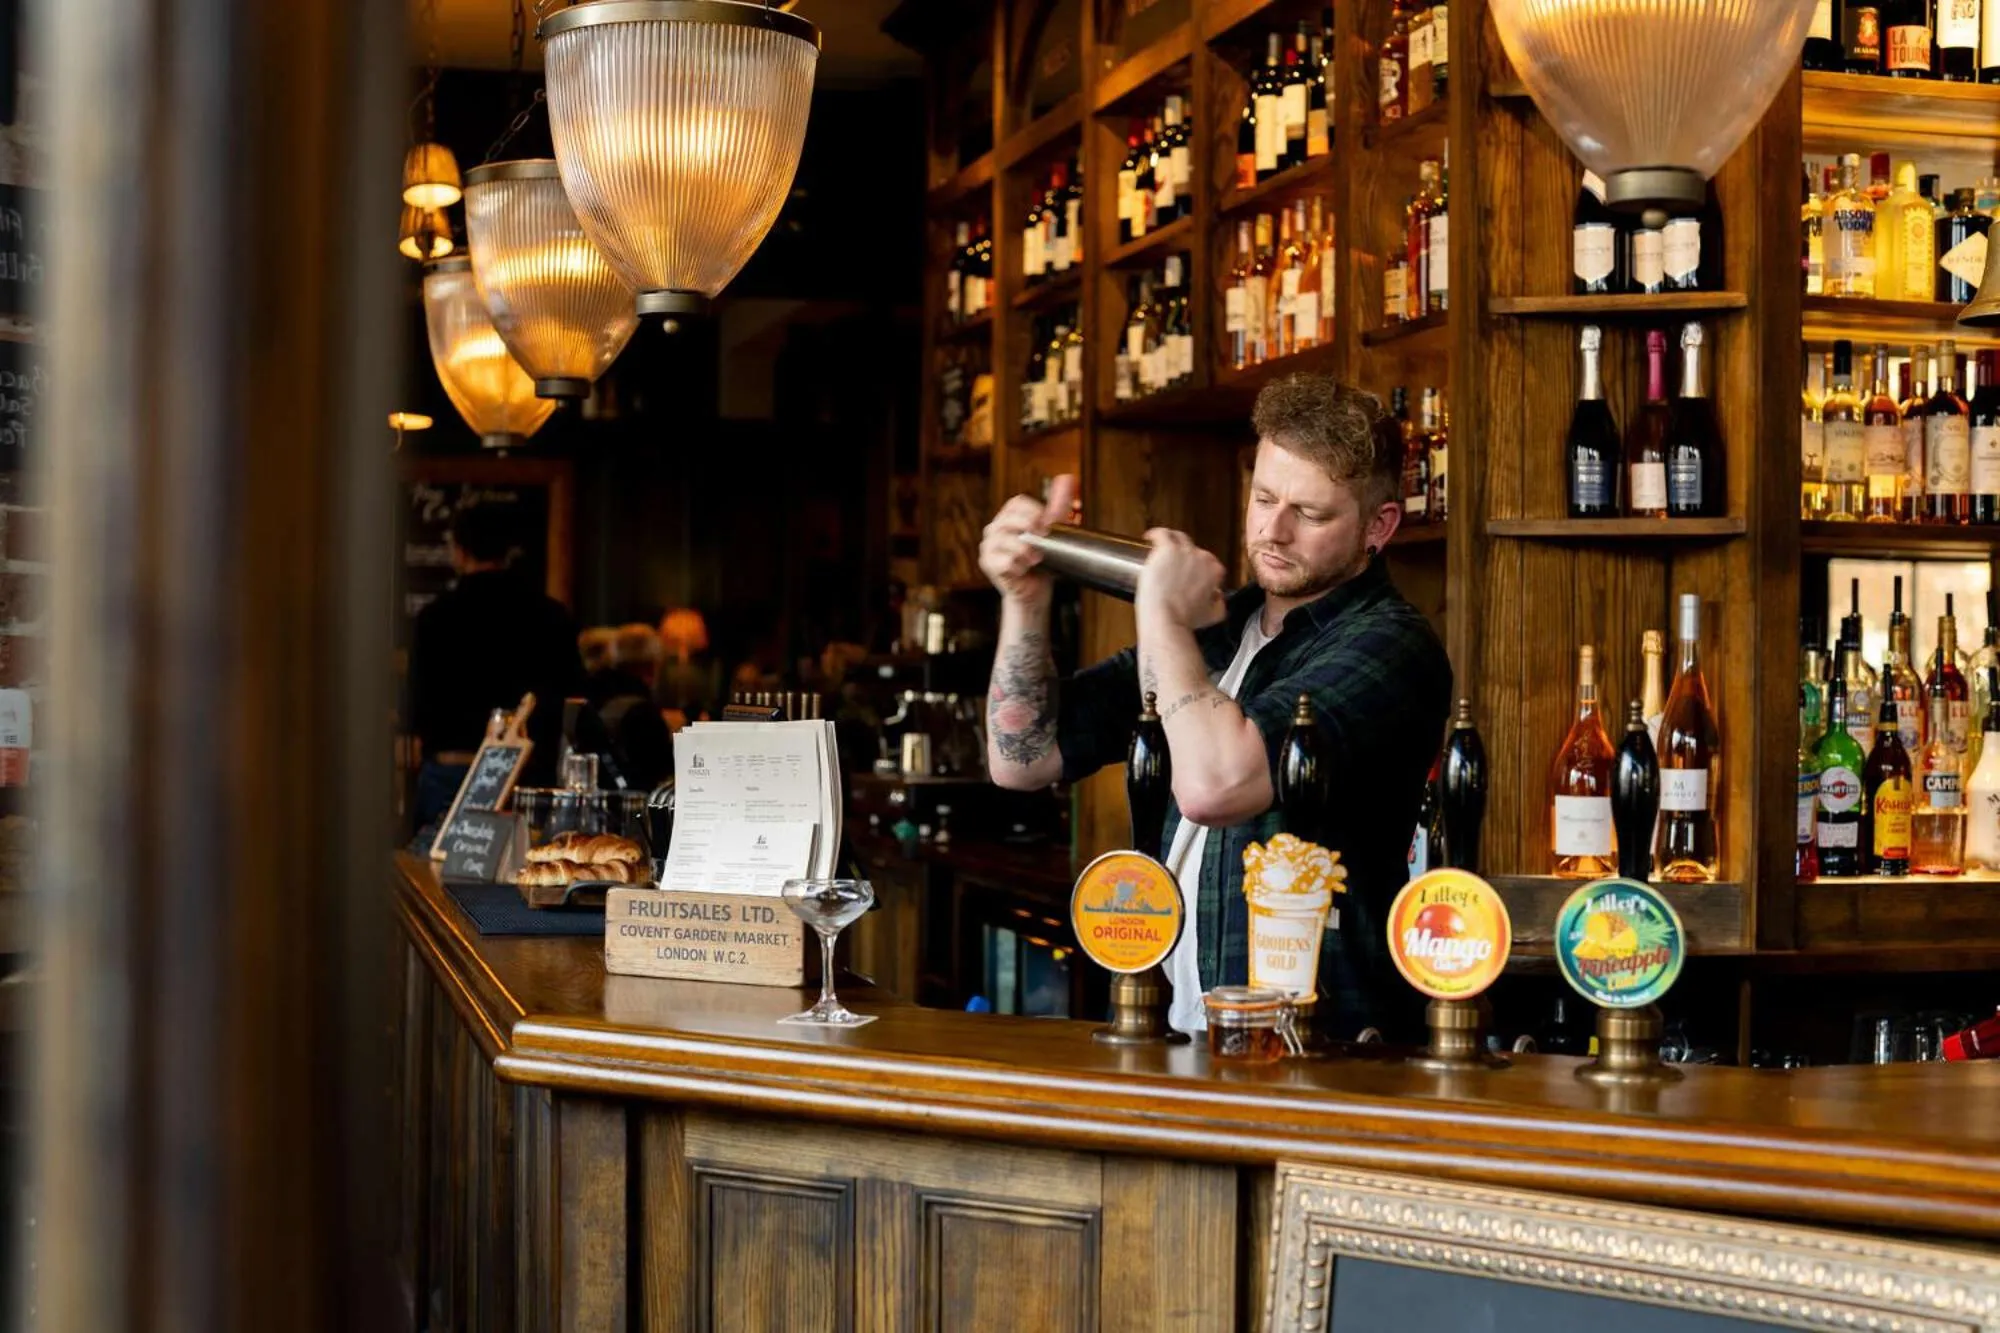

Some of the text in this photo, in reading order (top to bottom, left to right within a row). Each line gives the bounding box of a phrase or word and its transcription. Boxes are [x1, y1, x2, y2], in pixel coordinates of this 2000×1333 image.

[629, 900, 780, 924] FRUITSALES LTD.
[620, 924, 671, 939] COVENT
[674, 928, 727, 943] GARDEN
[1093, 925, 1162, 942] ORIGINAL
[657, 947, 706, 962] LONDON
[1403, 927, 1491, 967] Mango
[1267, 953, 1297, 971] GOLD
[1579, 944, 1671, 977] Pineapple
